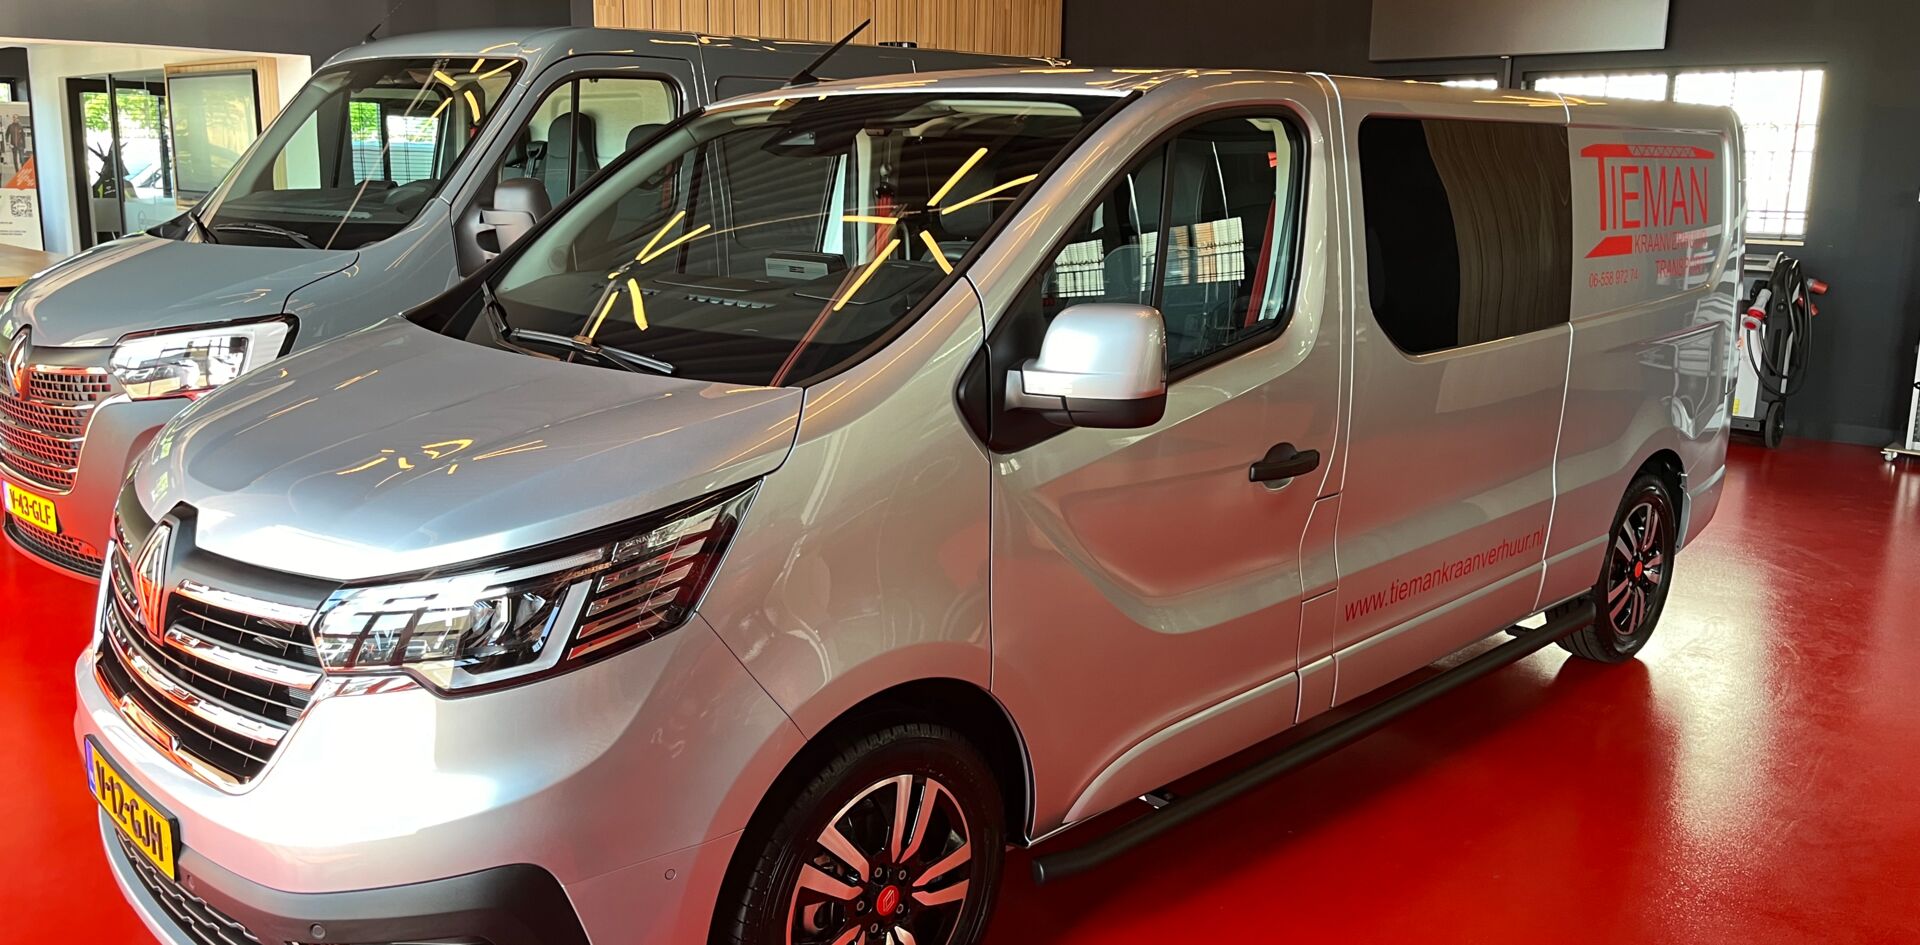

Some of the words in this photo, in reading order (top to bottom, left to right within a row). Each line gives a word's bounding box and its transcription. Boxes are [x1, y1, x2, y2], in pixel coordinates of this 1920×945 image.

[1580, 143, 1716, 231] TIEMAN
[9, 488, 51, 526] V-43-GLF
[1344, 527, 1545, 622] www.tiemankraanverhuur.nl
[95, 760, 164, 862] V-12-GJH
